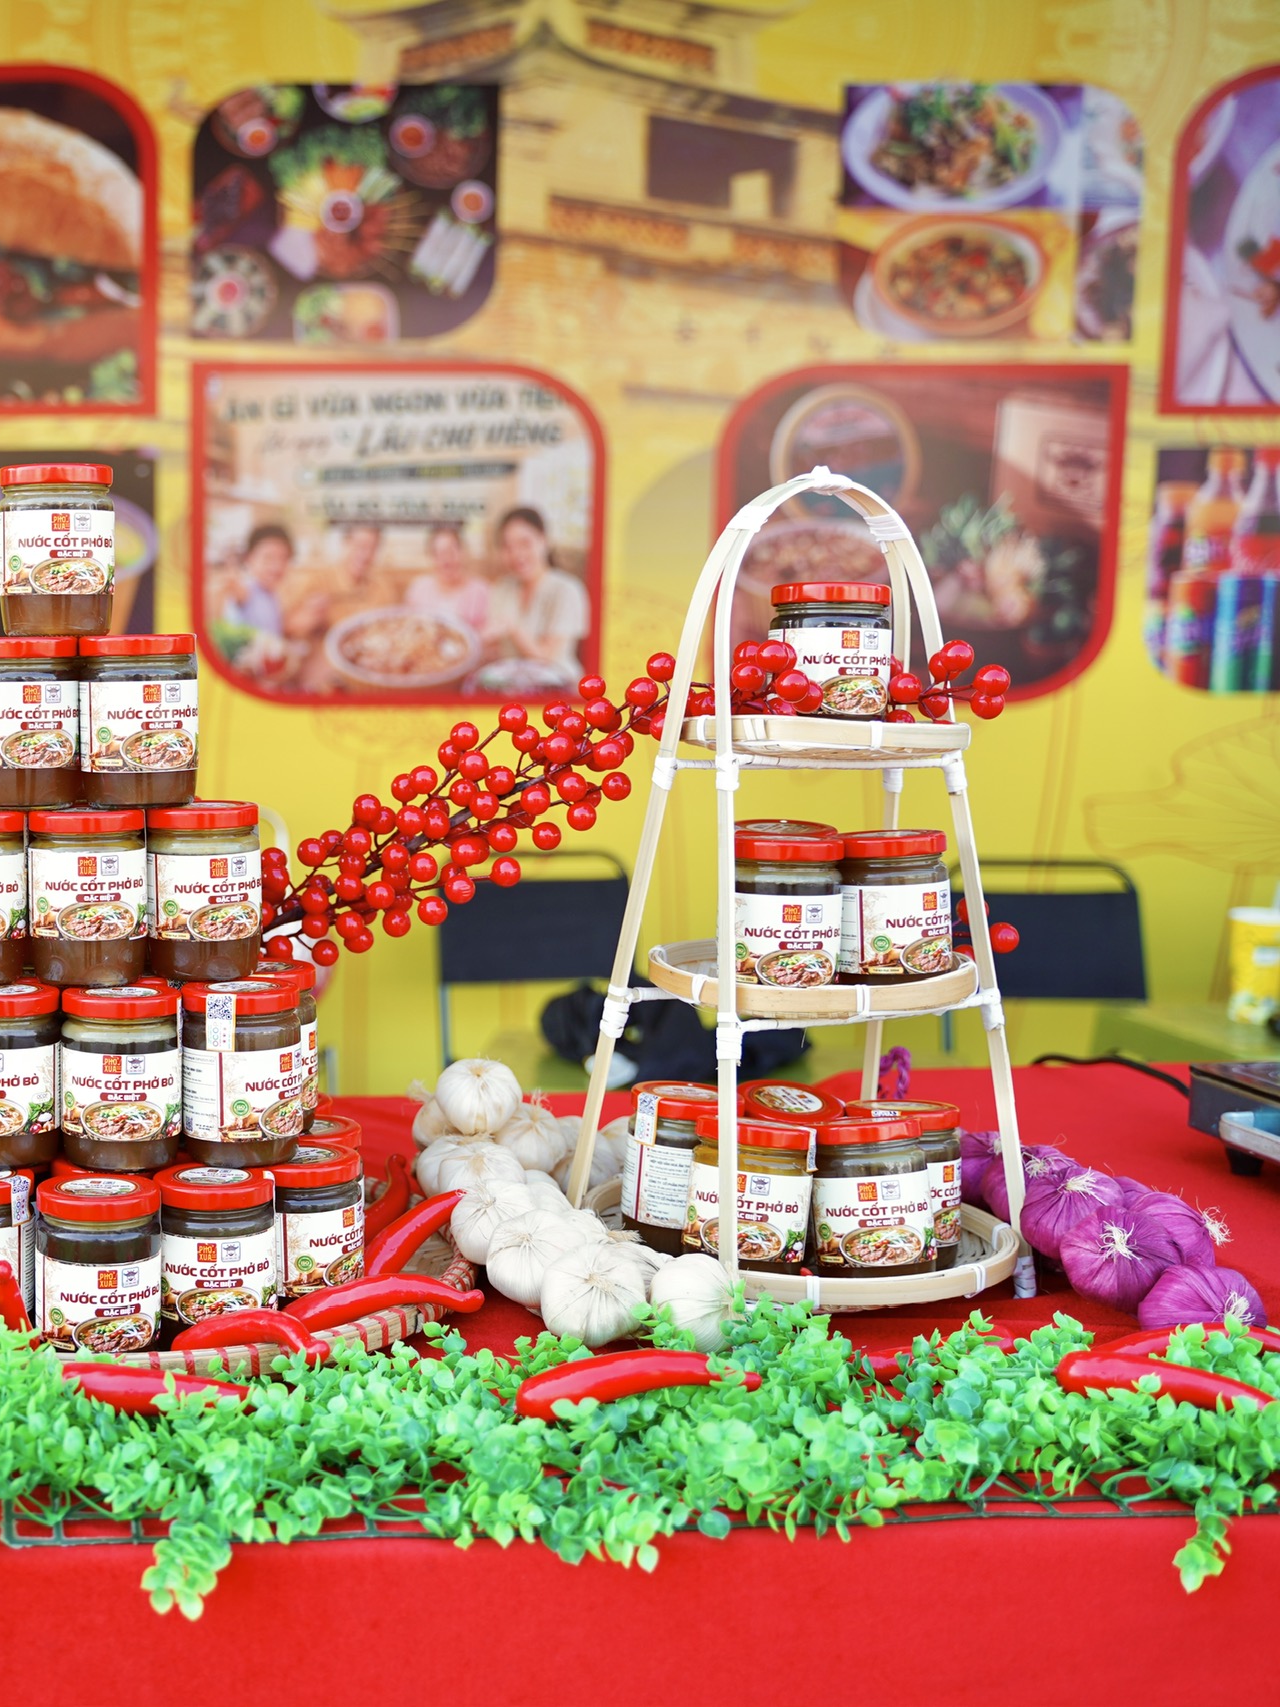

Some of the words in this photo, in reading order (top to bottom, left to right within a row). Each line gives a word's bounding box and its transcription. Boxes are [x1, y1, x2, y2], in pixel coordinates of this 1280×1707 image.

[18, 535, 51, 548] NƯỚC
[54, 533, 79, 547] CỐT
[81, 535, 103, 548] PHỞ
[803, 652, 840, 664] NƯỚC
[843, 650, 866, 664] CỐT
[25, 704, 49, 719] CỐT
[52, 708, 72, 719] PHỞ
[108, 707, 143, 720] NƯỚC
[146, 704, 169, 719] CỐT
[173, 708, 191, 719] PHỞ
[6, 880, 18, 893] BÒ
[45, 879, 77, 892] NƯỚC
[81, 877, 105, 891] CỐT
[109, 879, 132, 891] PHỞ
[174, 880, 209, 894] NƯỚC
[213, 879, 235, 893] CỐT
[238, 879, 256, 892] PHỞ
[886, 915, 923, 929] NƯỚC
[925, 910, 942, 926] CỐT
[744, 925, 781, 938] NƯỚC
[784, 924, 809, 939] CỐT
[812, 925, 832, 938] PHỞ
[23, 1073, 39, 1085] BÒ
[72, 1075, 102, 1090] NƯỚC
[105, 1072, 128, 1091] CỐT
[134, 1076, 159, 1091] PHỞ
[162, 1073, 174, 1087] BÒ
[245, 1077, 280, 1092] NƯỚC
[282, 1072, 298, 1088] CỐT
[695, 1190, 719, 1203] NƯỚ
[756, 1202, 783, 1213] PHỞ
[785, 1201, 798, 1213] BÒ
[826, 1204, 859, 1217] NƯỚC
[862, 1201, 888, 1216] CỐT
[891, 1202, 916, 1215] PHỞ
[309, 1234, 341, 1248] NƯỚC
[344, 1227, 360, 1244] CỐT
[165, 1262, 197, 1276] NƯỚC
[200, 1259, 227, 1277] CỐT
[231, 1260, 255, 1276] PHỞ
[257, 1258, 269, 1272] BÒ
[60, 1290, 97, 1305] NƯỚC
[101, 1287, 125, 1304] CỐT
[129, 1286, 150, 1302] PHỞ
